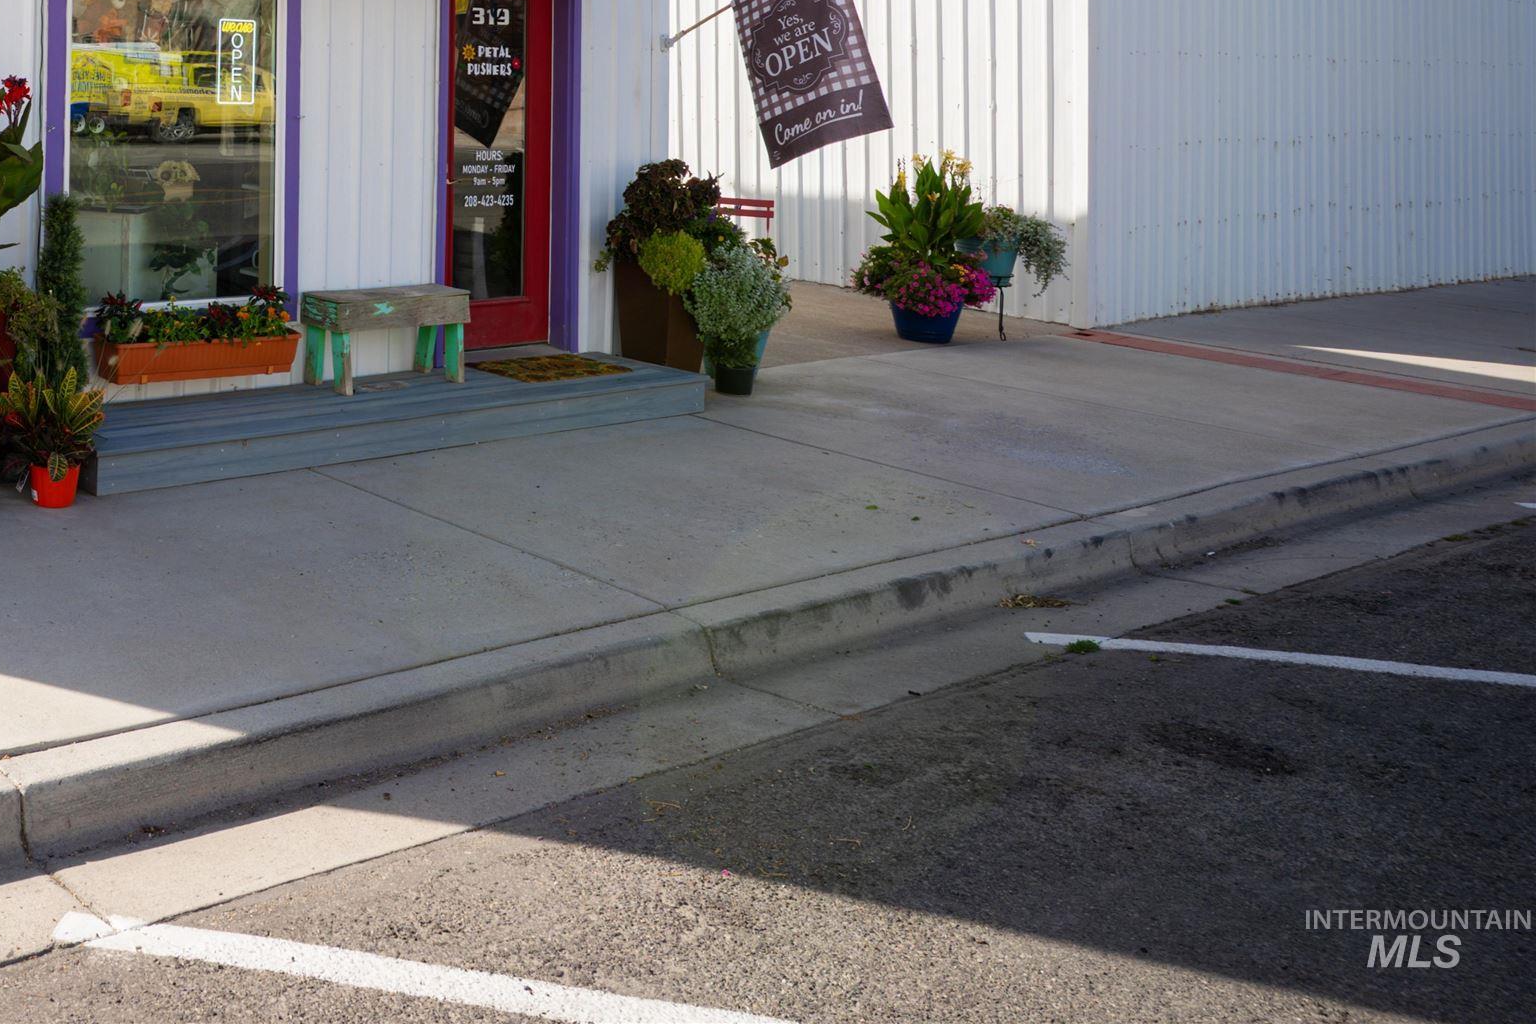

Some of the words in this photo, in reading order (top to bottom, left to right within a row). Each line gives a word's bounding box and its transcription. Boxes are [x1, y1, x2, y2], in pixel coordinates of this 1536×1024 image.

[777, 13, 804, 31] Yes,
[773, 32, 791, 46] we
[795, 21, 815, 38] are
[478, 45, 511, 58] PETAL
[765, 27, 833, 77] OPEN
[231, 33, 244, 101] OPEN
[467, 62, 512, 76] PUSHERS
[774, 117, 813, 146] Come
[816, 109, 836, 125] on
[840, 89, 864, 114] in!
[475, 150, 503, 161] HOURS:
[462, 164, 488, 174] MONDAY
[494, 164, 516, 173] FRIDAY
[473, 177, 486, 186] 9am
[492, 176, 506, 187] 5pm
[464, 194, 514, 207] 208-423-4235
